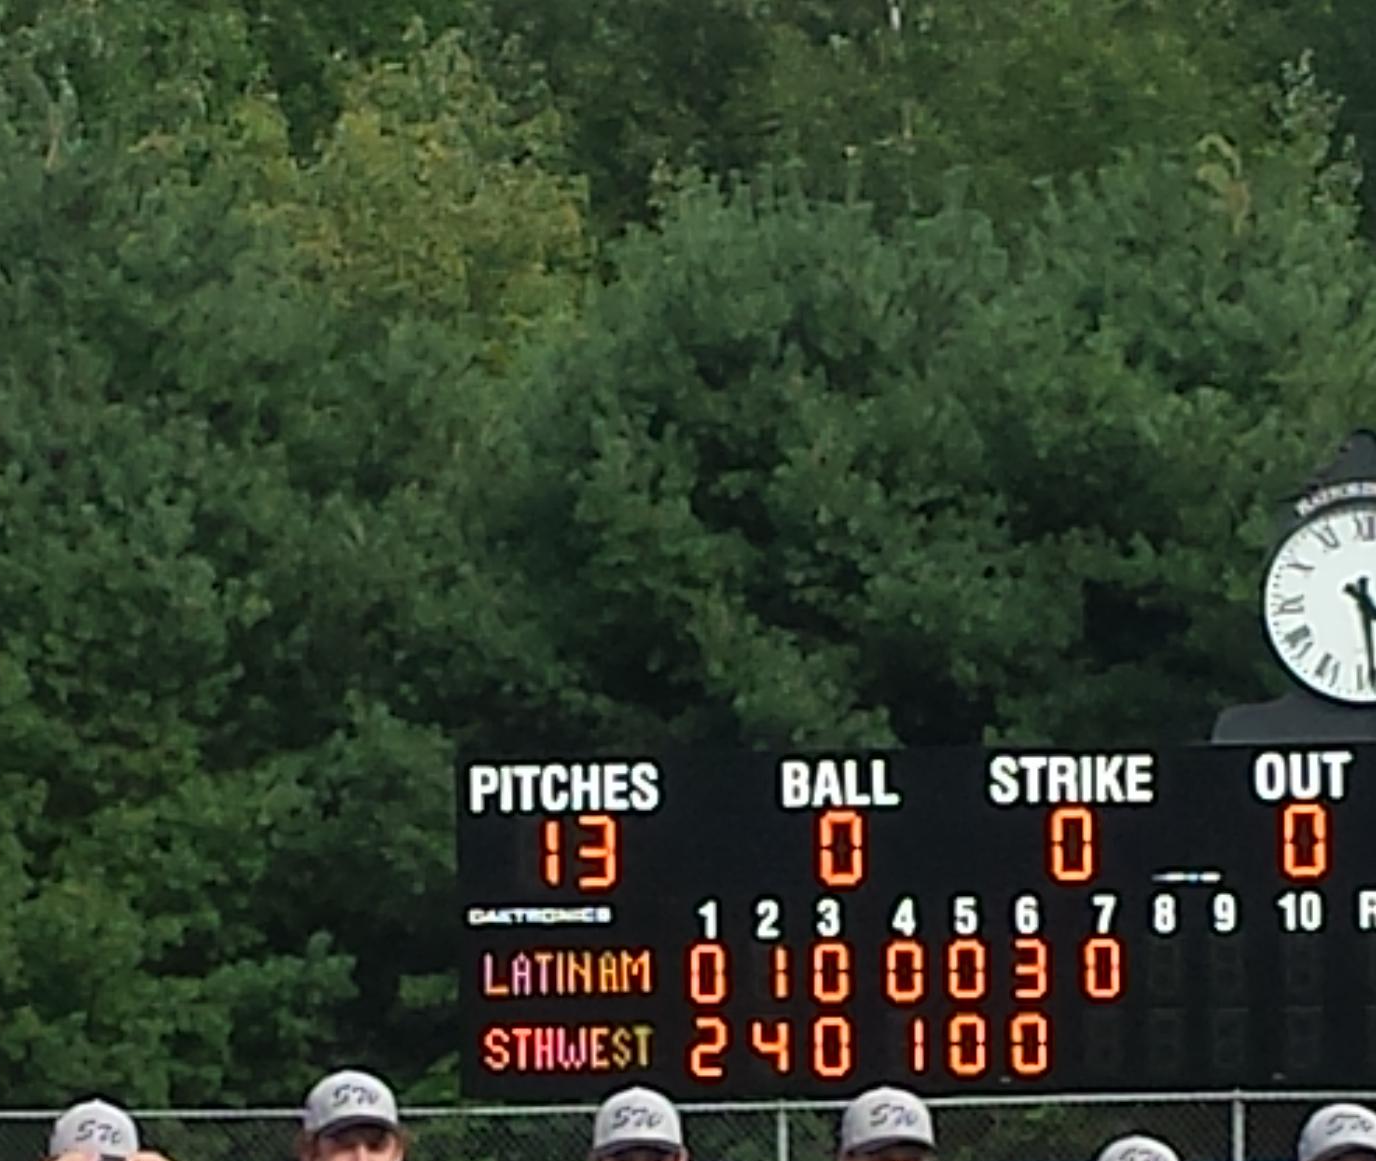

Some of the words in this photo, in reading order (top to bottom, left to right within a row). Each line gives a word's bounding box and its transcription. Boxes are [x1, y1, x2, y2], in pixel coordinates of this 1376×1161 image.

[470, 762, 659, 812] PITCHES
[782, 759, 900, 808] BALL
[989, 755, 1154, 804] STRIKE
[1255, 751, 1353, 800] OUT
[540, 815, 616, 887] 13
[820, 811, 863, 885] 0
[1051, 808, 1093, 881] 0
[1283, 804, 1326, 877] 0
[697, 901, 717, 940] 1
[756, 899, 779, 938] 2
[816, 898, 840, 937] 3
[892, 898, 916, 937] 4
[954, 896, 978, 936] 5
[1015, 895, 1039, 935] 6
[1091, 895, 1117, 934] 7
[1154, 894, 1176, 933] 8
[1213, 893, 1236, 932] 9
[1278, 891, 1322, 931] 10
[484, 950, 651, 996] LATINAM
[690, 944, 725, 1004] 0
[775, 948, 787, 998] 1
[813, 943, 849, 1002] 0
[886, 941, 923, 1001] 0
[948, 939, 985, 999] 0
[1014, 938, 1047, 998] 3
[1084, 938, 1120, 998] 0
[484, 1026, 653, 1070] STHWEST
[691, 1017, 727, 1077] 2
[752, 1022, 789, 1071] 4
[814, 1016, 850, 1077] 0
[913, 1020, 924, 1071] 1
[949, 1014, 986, 1074] 0
[1011, 1013, 1047, 1074] 0
